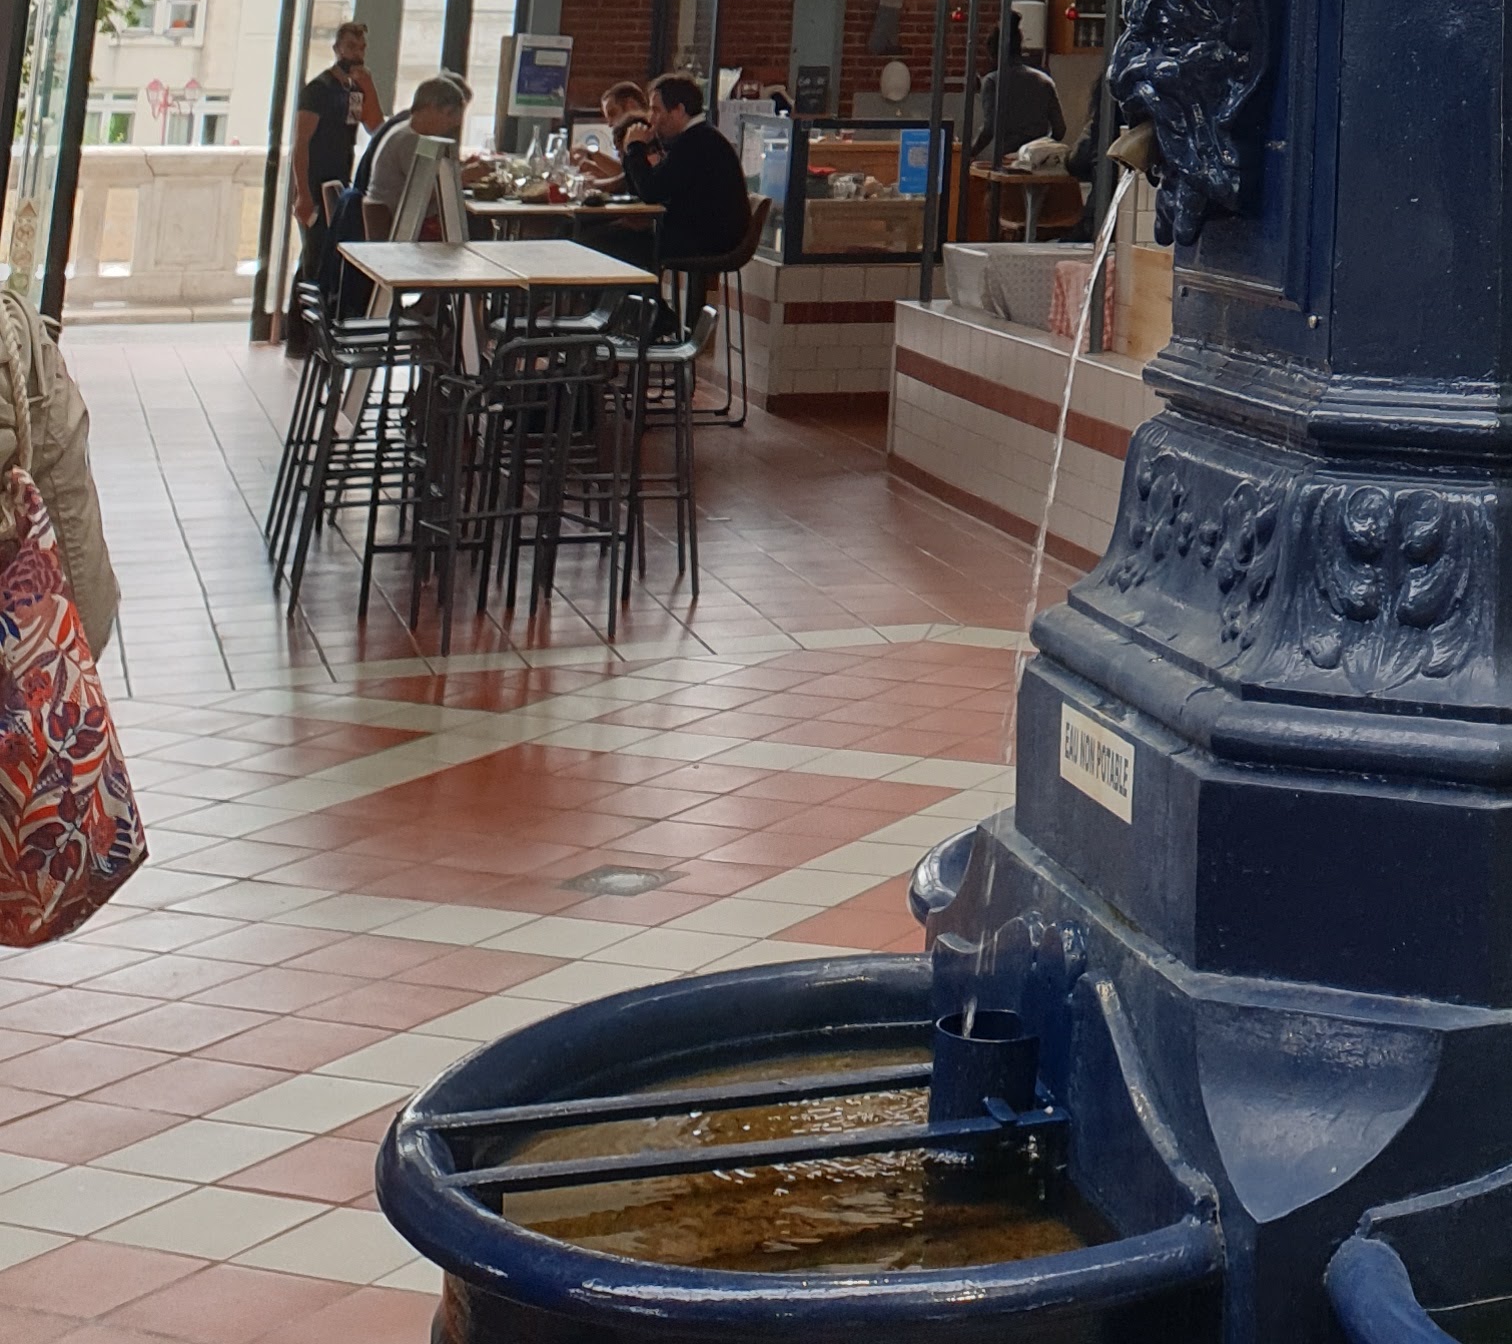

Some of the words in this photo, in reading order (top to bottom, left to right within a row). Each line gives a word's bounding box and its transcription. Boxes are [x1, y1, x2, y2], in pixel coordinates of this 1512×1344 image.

[1065, 721, 1079, 765] EAU
[1080, 730, 1096, 776] NON
[1096, 741, 1129, 799] POTABLE
